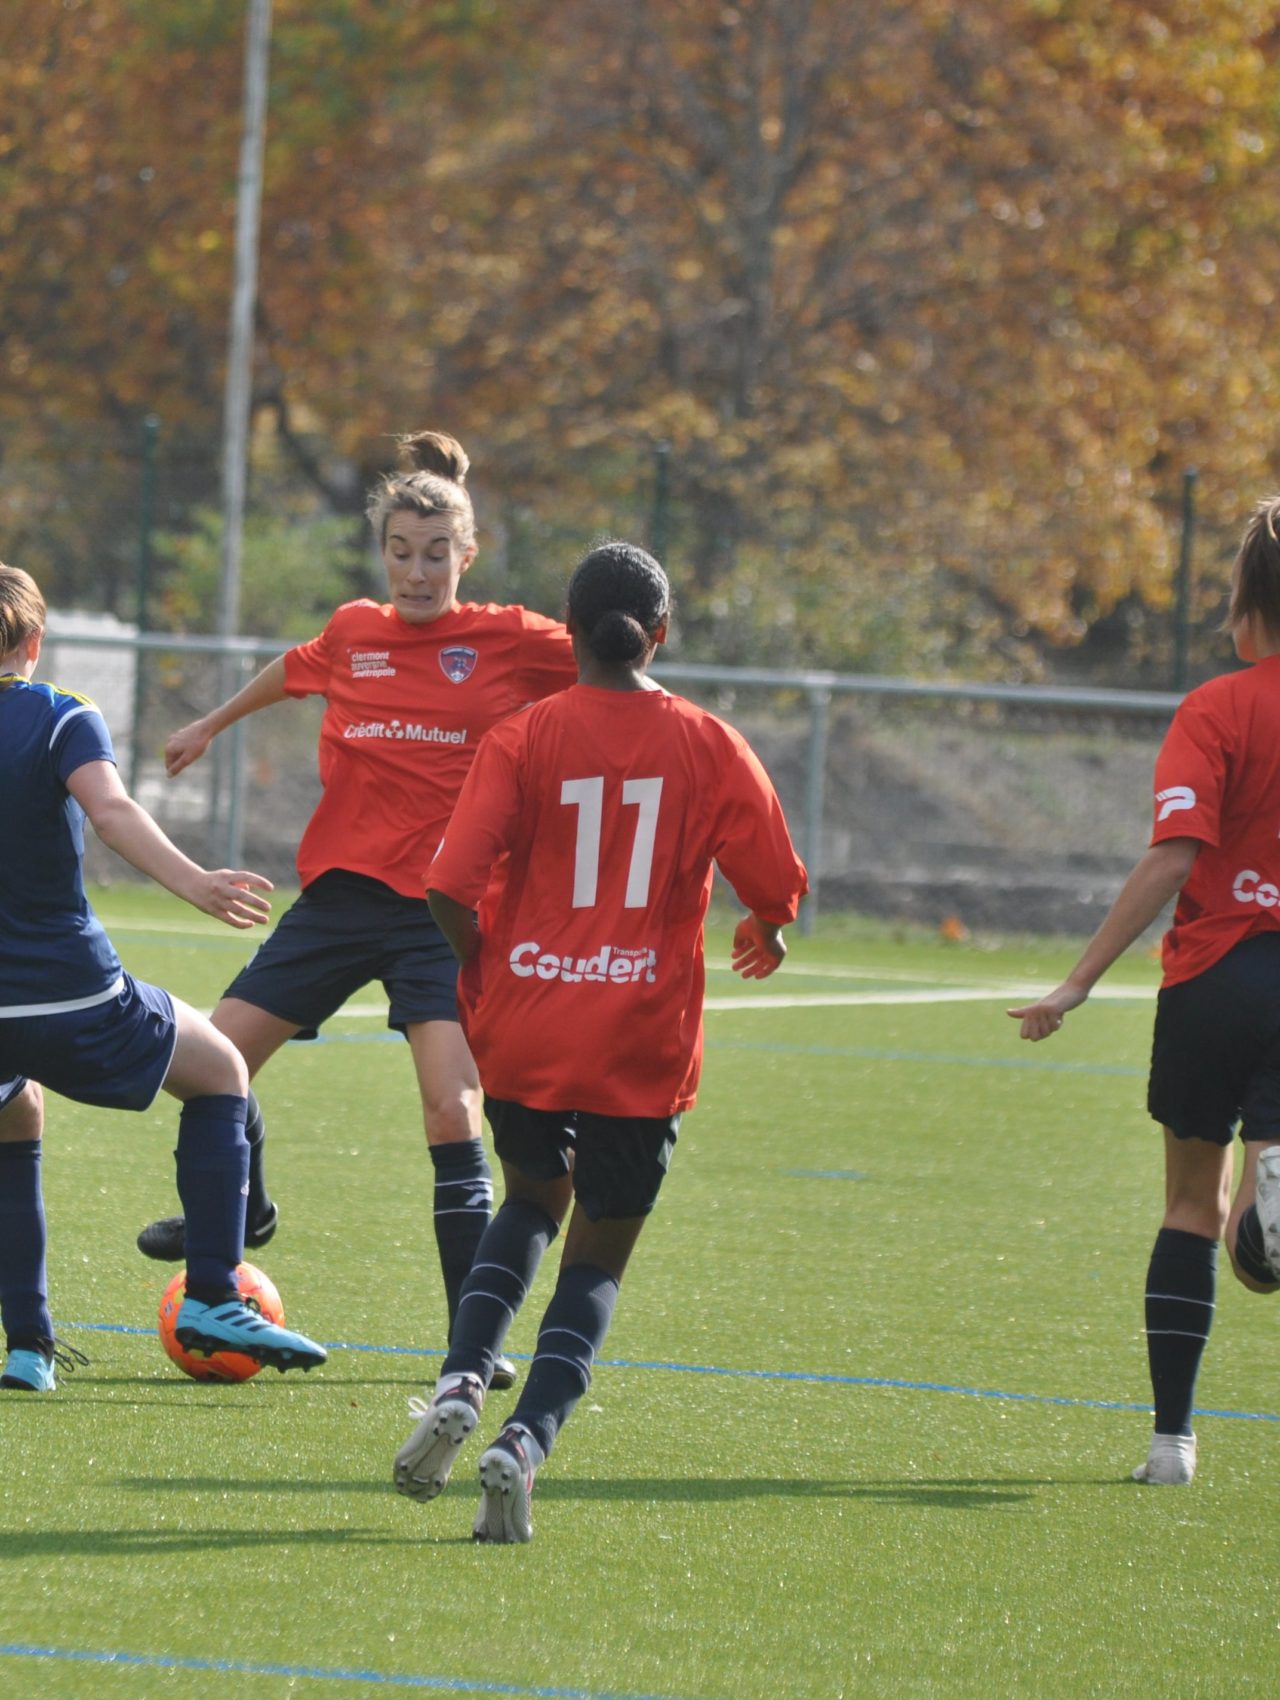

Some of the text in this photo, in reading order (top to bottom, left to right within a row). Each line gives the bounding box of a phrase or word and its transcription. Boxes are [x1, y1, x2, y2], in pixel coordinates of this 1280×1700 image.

[351, 652, 390, 662] clermont
[343, 722, 468, 745] Crédit Mutuel
[560, 776, 664, 909] 11
[1232, 869, 1280, 908] Co
[509, 941, 657, 984] Coudert
